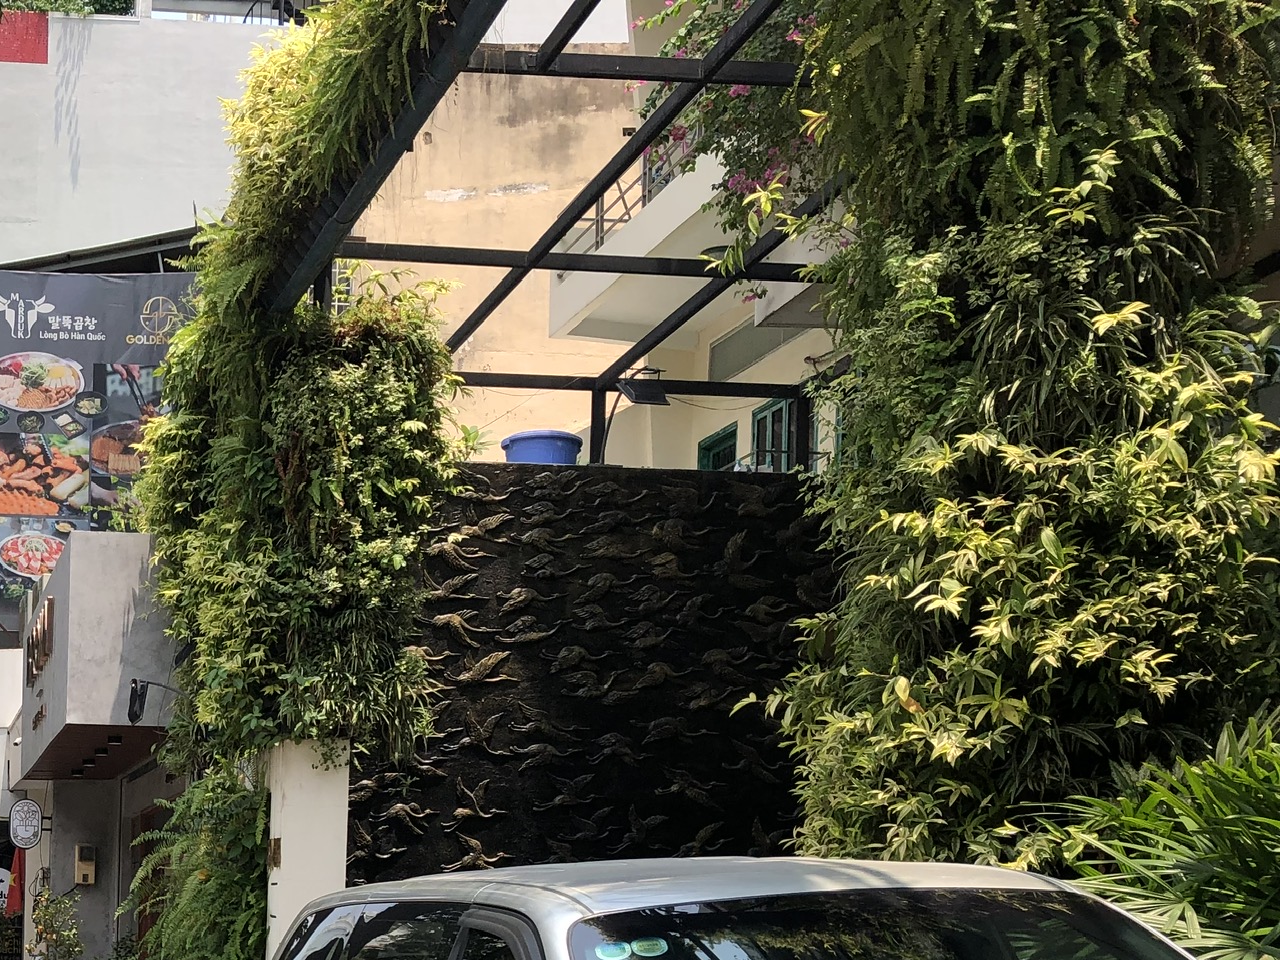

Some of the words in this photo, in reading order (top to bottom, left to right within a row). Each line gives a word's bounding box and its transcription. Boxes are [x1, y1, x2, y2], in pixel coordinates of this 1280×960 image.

[10, 293, 25, 338] MARDUK
[48, 315, 97, 330] 말뚝곱창
[39, 331, 58, 341] Lòng
[59, 331, 69, 340] Bò
[71, 332, 85, 340] Hàn
[86, 332, 106, 341] Quốc
[126, 335, 169, 344] GOLDEN
